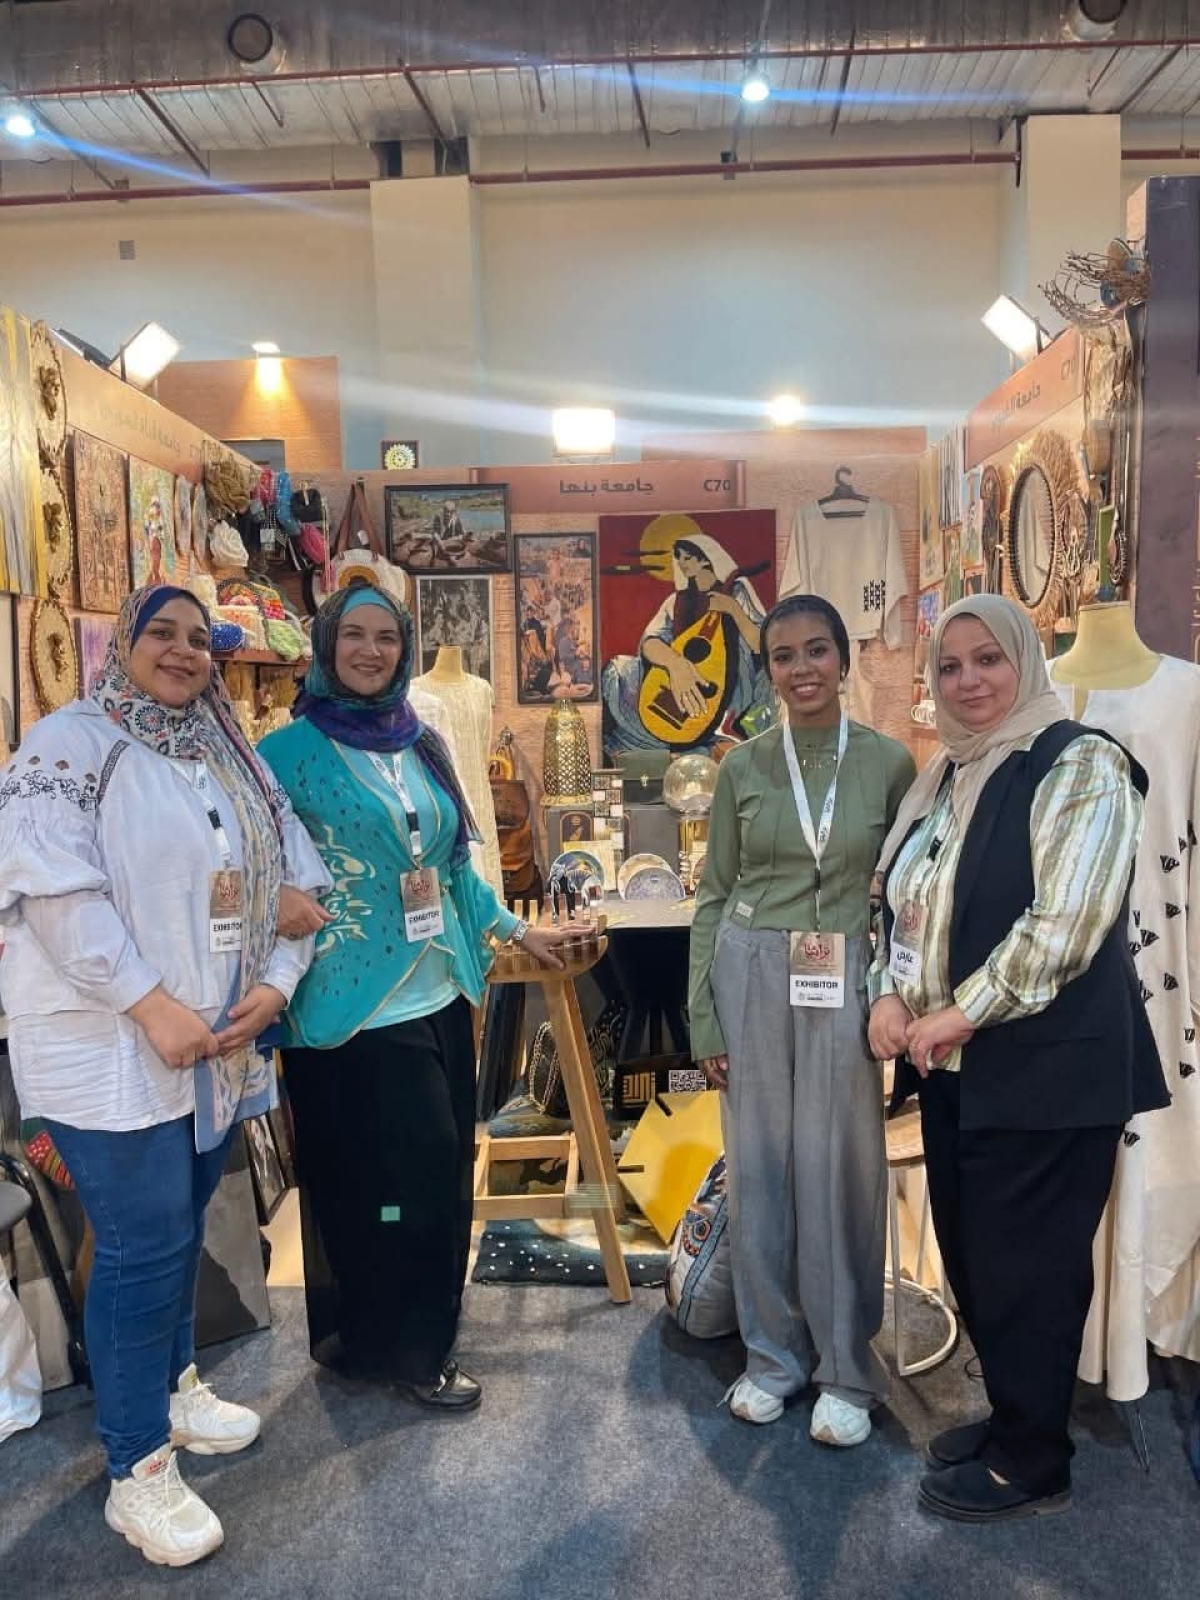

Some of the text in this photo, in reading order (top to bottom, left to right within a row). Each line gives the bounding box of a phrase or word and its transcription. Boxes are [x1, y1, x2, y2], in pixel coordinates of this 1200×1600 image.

[559, 478, 654, 497] جامعة بنها
[703, 479, 732, 492] C70
[213, 921, 242, 932] EXHIBITO
[795, 979, 838, 989] EXHIBITOR
